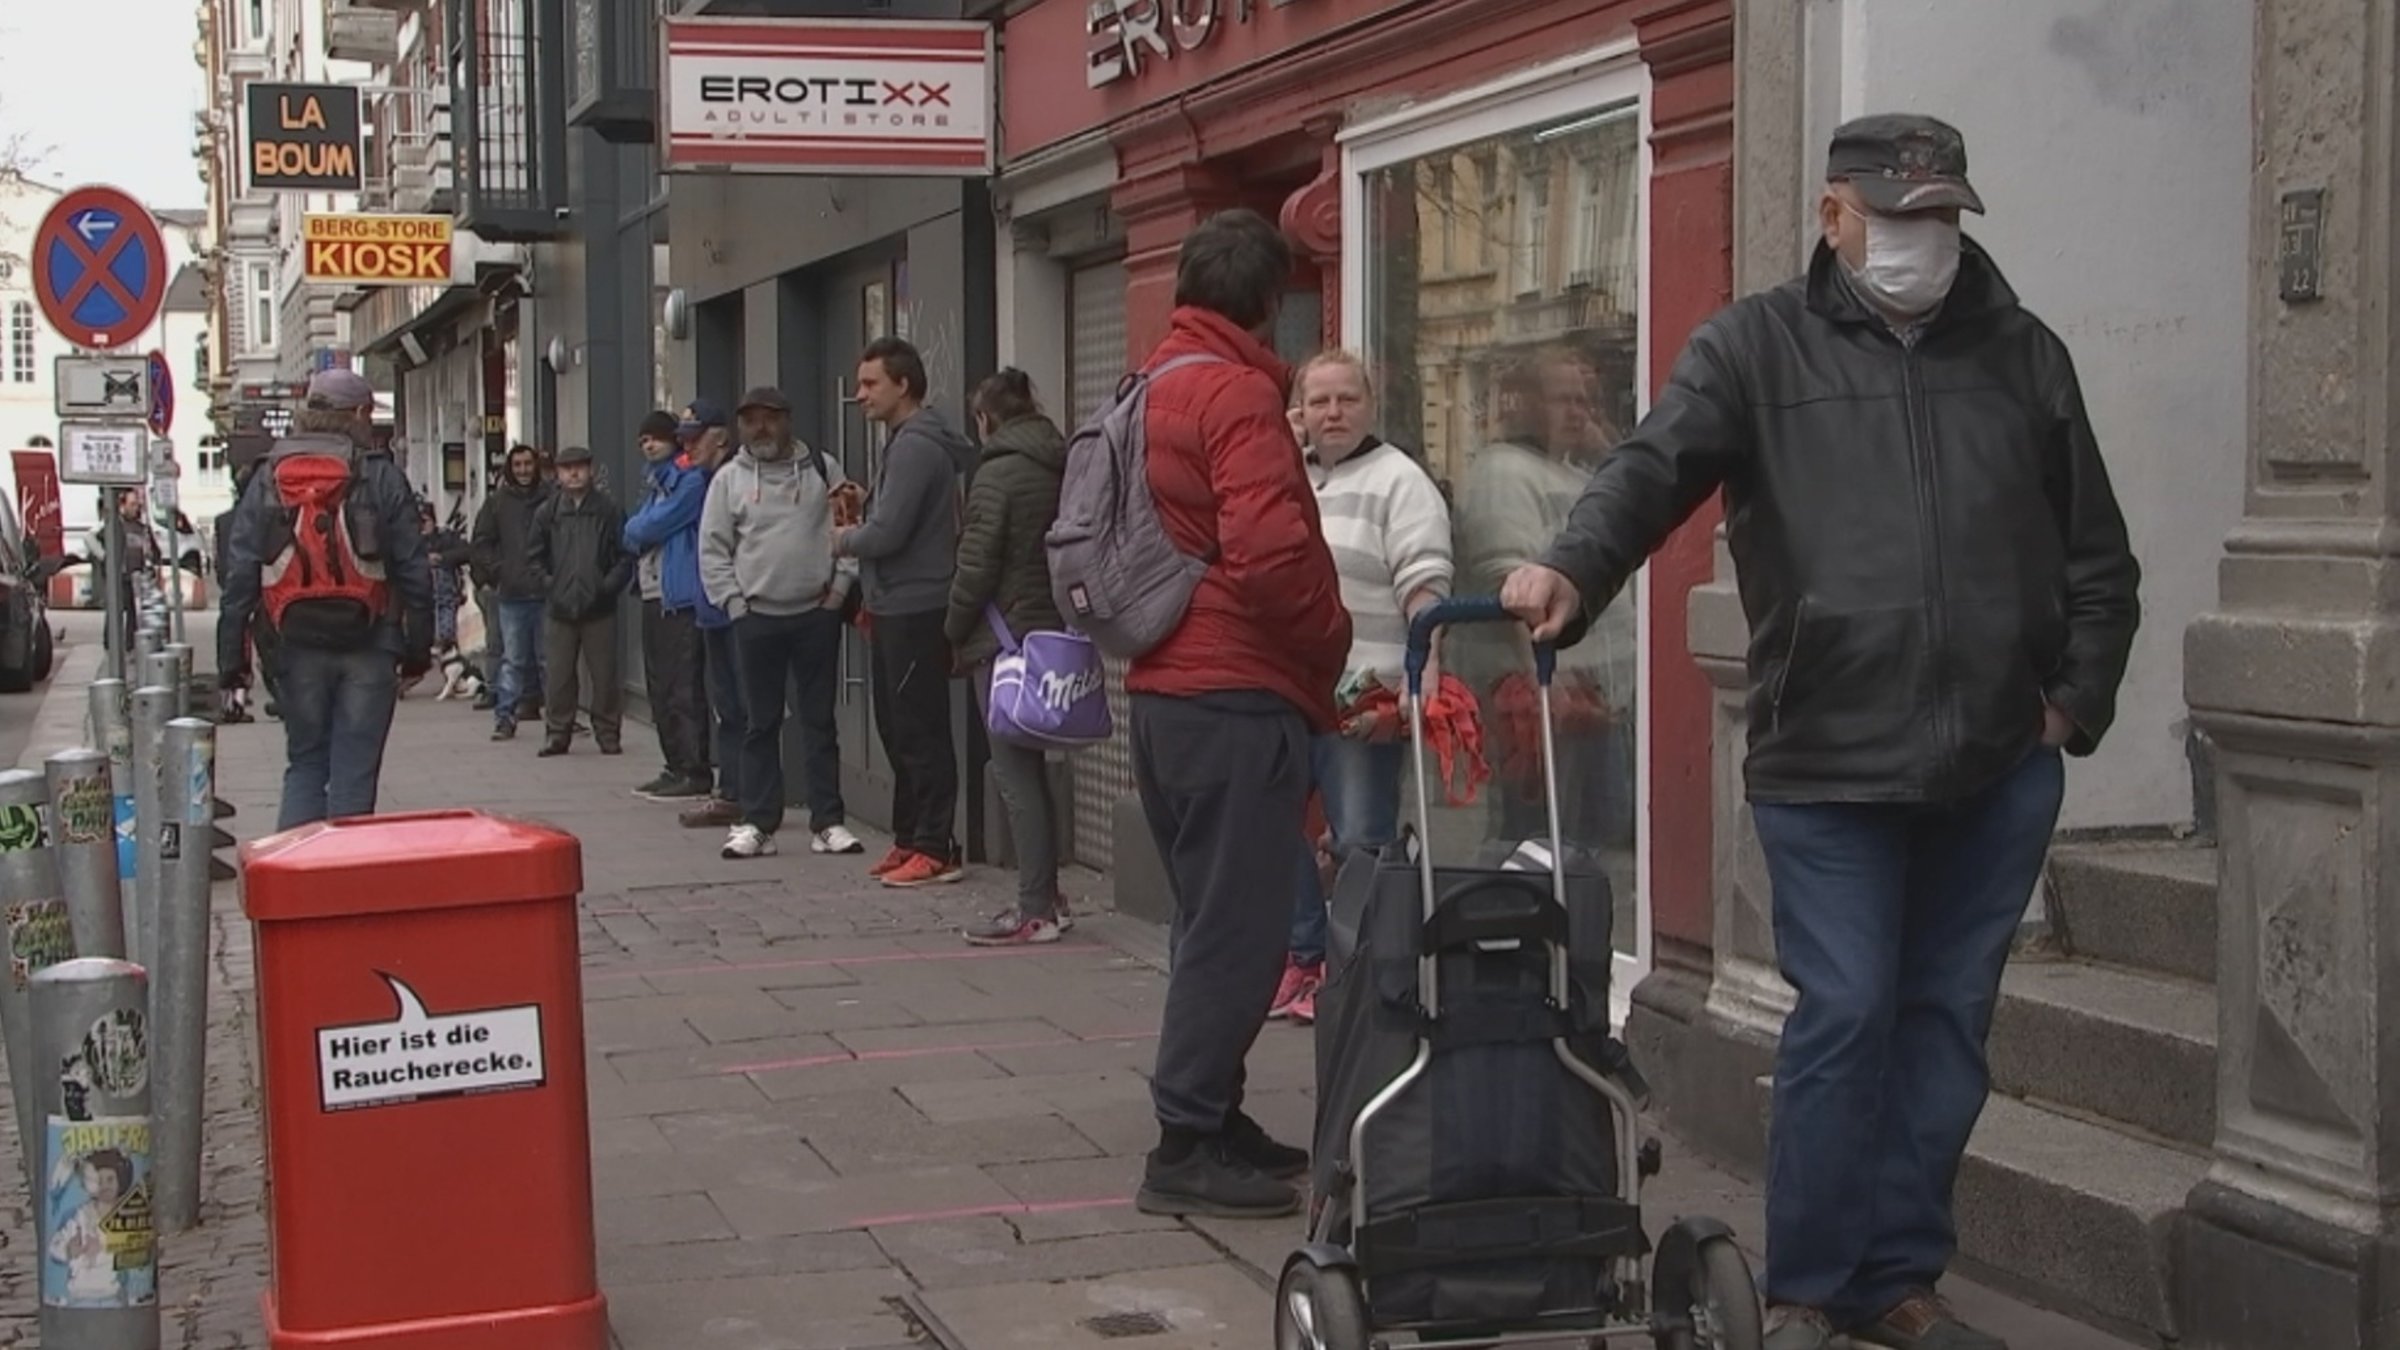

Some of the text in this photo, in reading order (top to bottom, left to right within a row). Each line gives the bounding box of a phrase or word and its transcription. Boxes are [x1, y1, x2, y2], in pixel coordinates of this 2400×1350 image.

[701, 76, 950, 107] EROTIXX
[280, 95, 326, 130] LA
[844, 114, 949, 127] STORE
[254, 141, 355, 176] BOUM
[311, 218, 445, 239] BERG-STORE
[311, 242, 445, 278] KIOSK
[330, 1023, 490, 1059] Hier ist die
[332, 1051, 533, 1091] Raucherecke.
